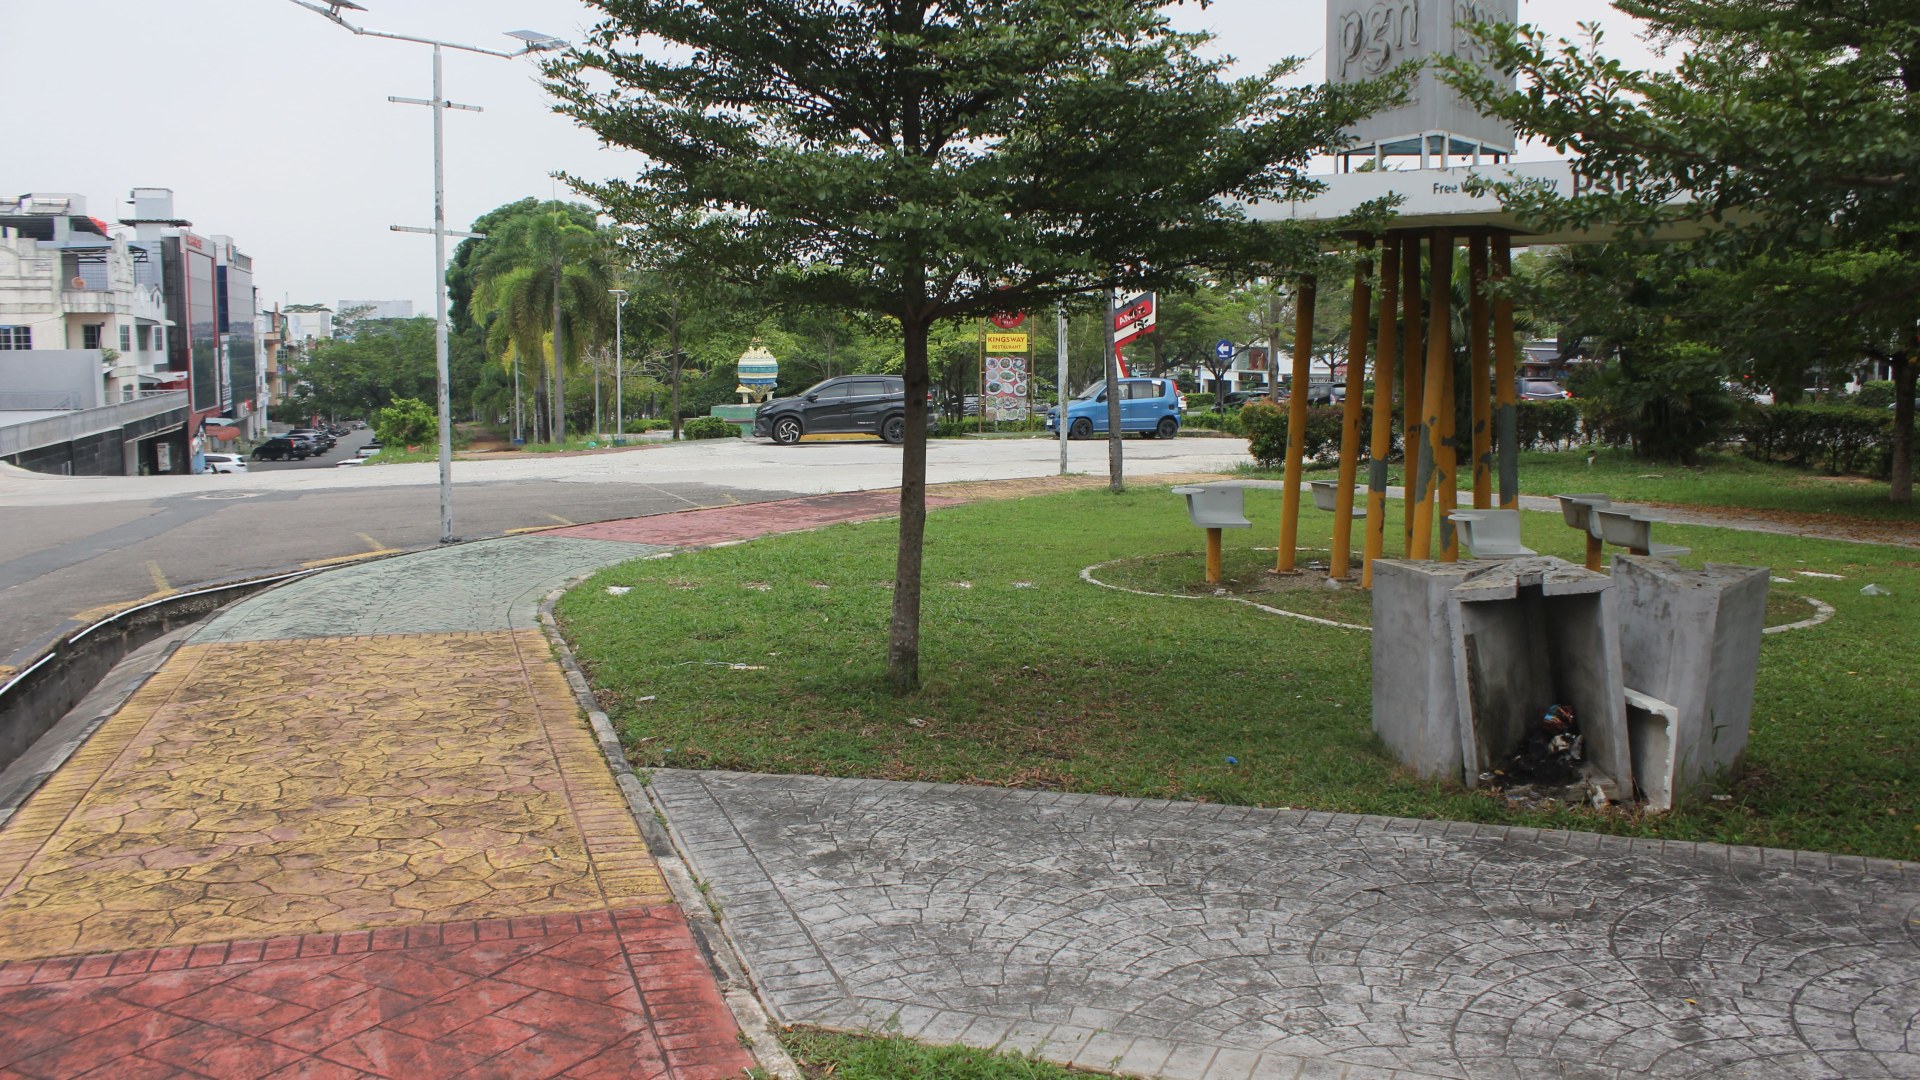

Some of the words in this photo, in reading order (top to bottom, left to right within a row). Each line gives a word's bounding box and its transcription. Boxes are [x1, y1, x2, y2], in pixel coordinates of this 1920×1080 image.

[1338, 0, 1420, 79] pgn
[1433, 181, 1458, 195] Free
[1543, 176, 1558, 193] by
